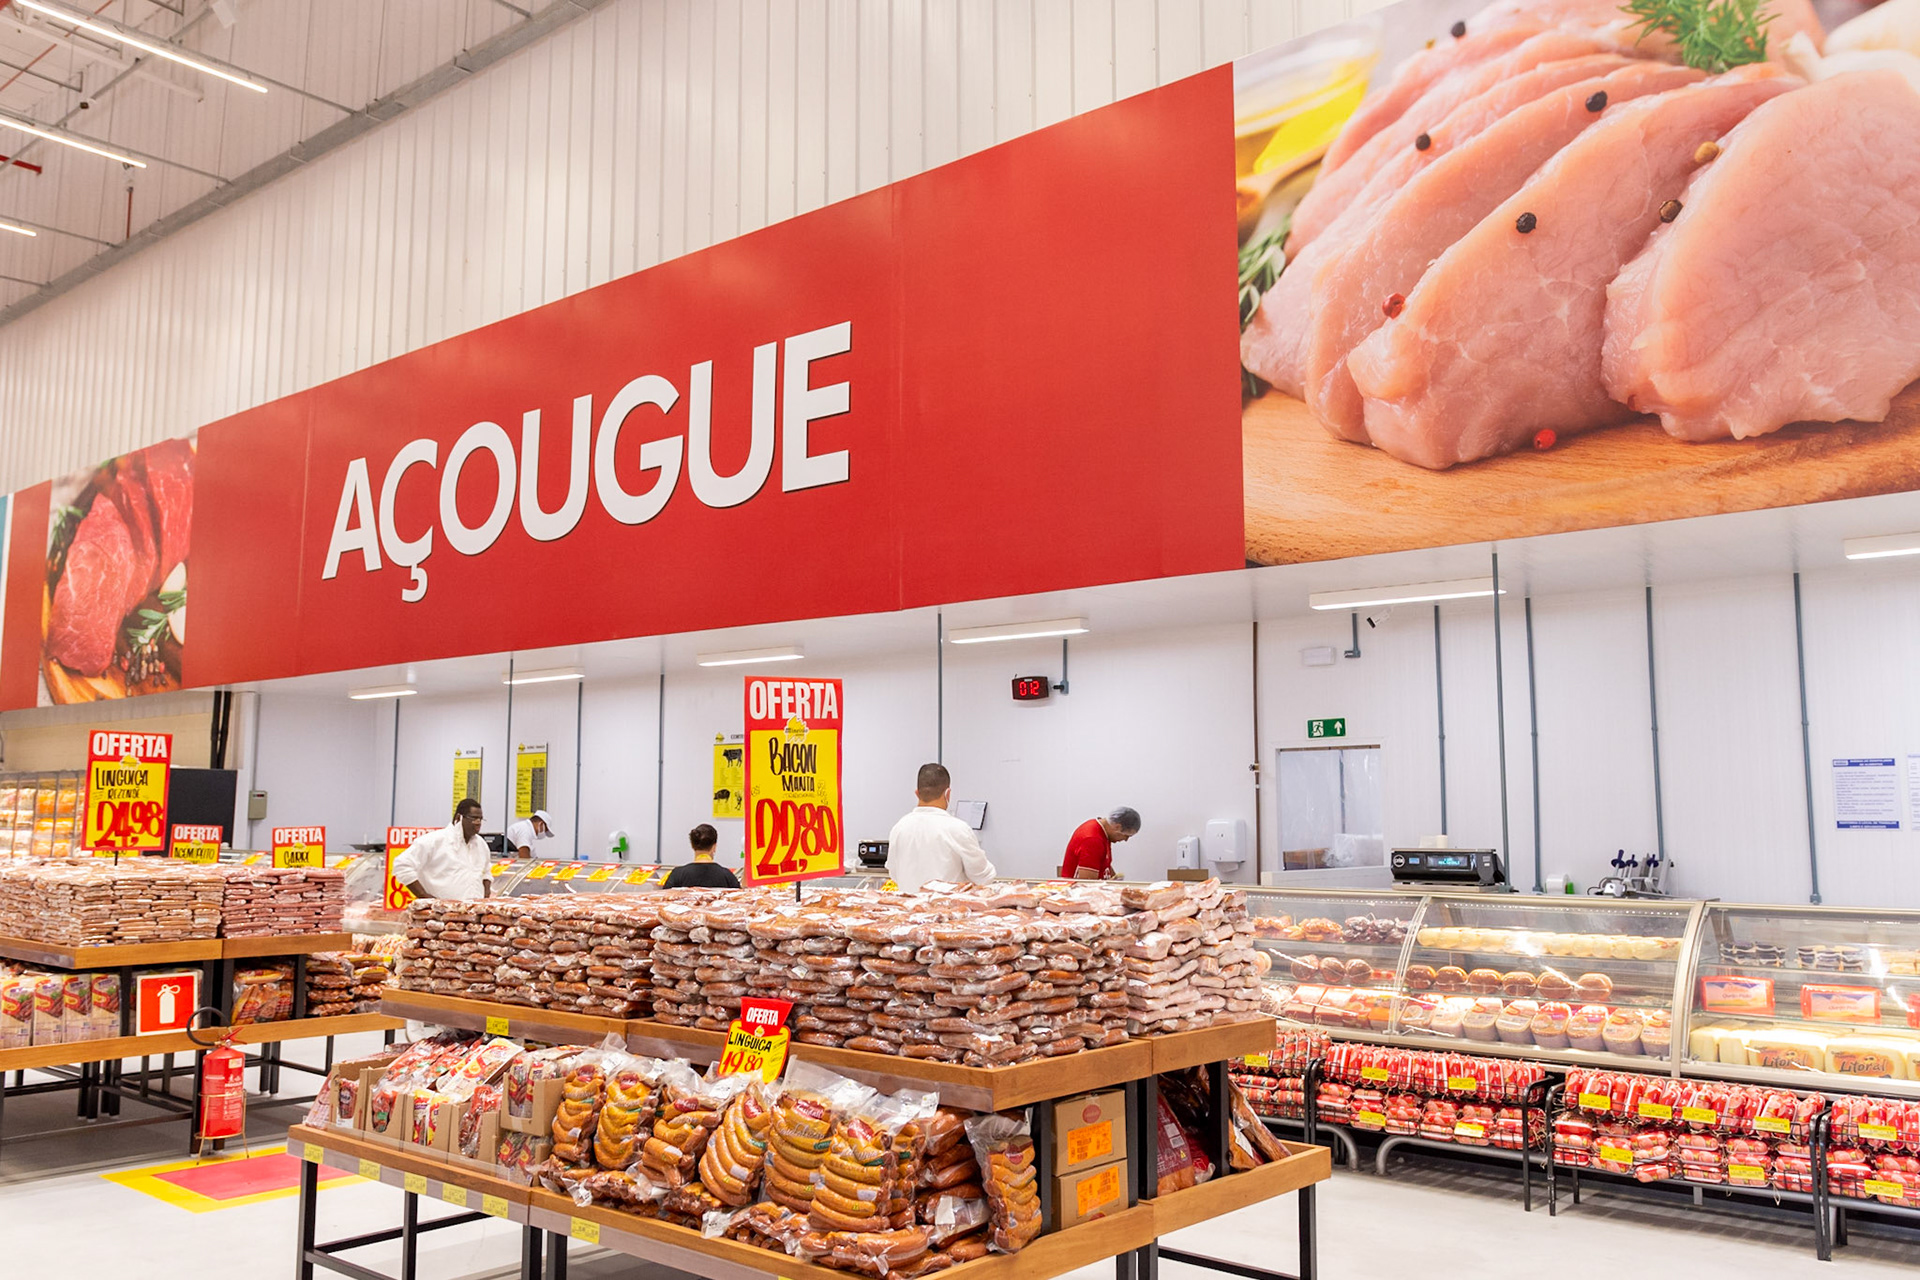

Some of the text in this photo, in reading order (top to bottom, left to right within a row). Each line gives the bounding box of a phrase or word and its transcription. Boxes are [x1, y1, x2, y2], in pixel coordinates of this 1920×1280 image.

[322, 321, 851, 603] AÇOUGUE
[1019, 680, 1040, 696] 012
[750, 680, 838, 720] OFERTA
[93, 732, 167, 758] OFERTA
[768, 737, 817, 775] BACON
[782, 775, 815, 792] MANTA
[174, 826, 220, 841] OFERTA
[274, 827, 323, 844] OFERTA
[755, 798, 837, 876] 22,80
[746, 1007, 778, 1026] OFERTA
[1839, 1057, 1888, 1074] Litoral
